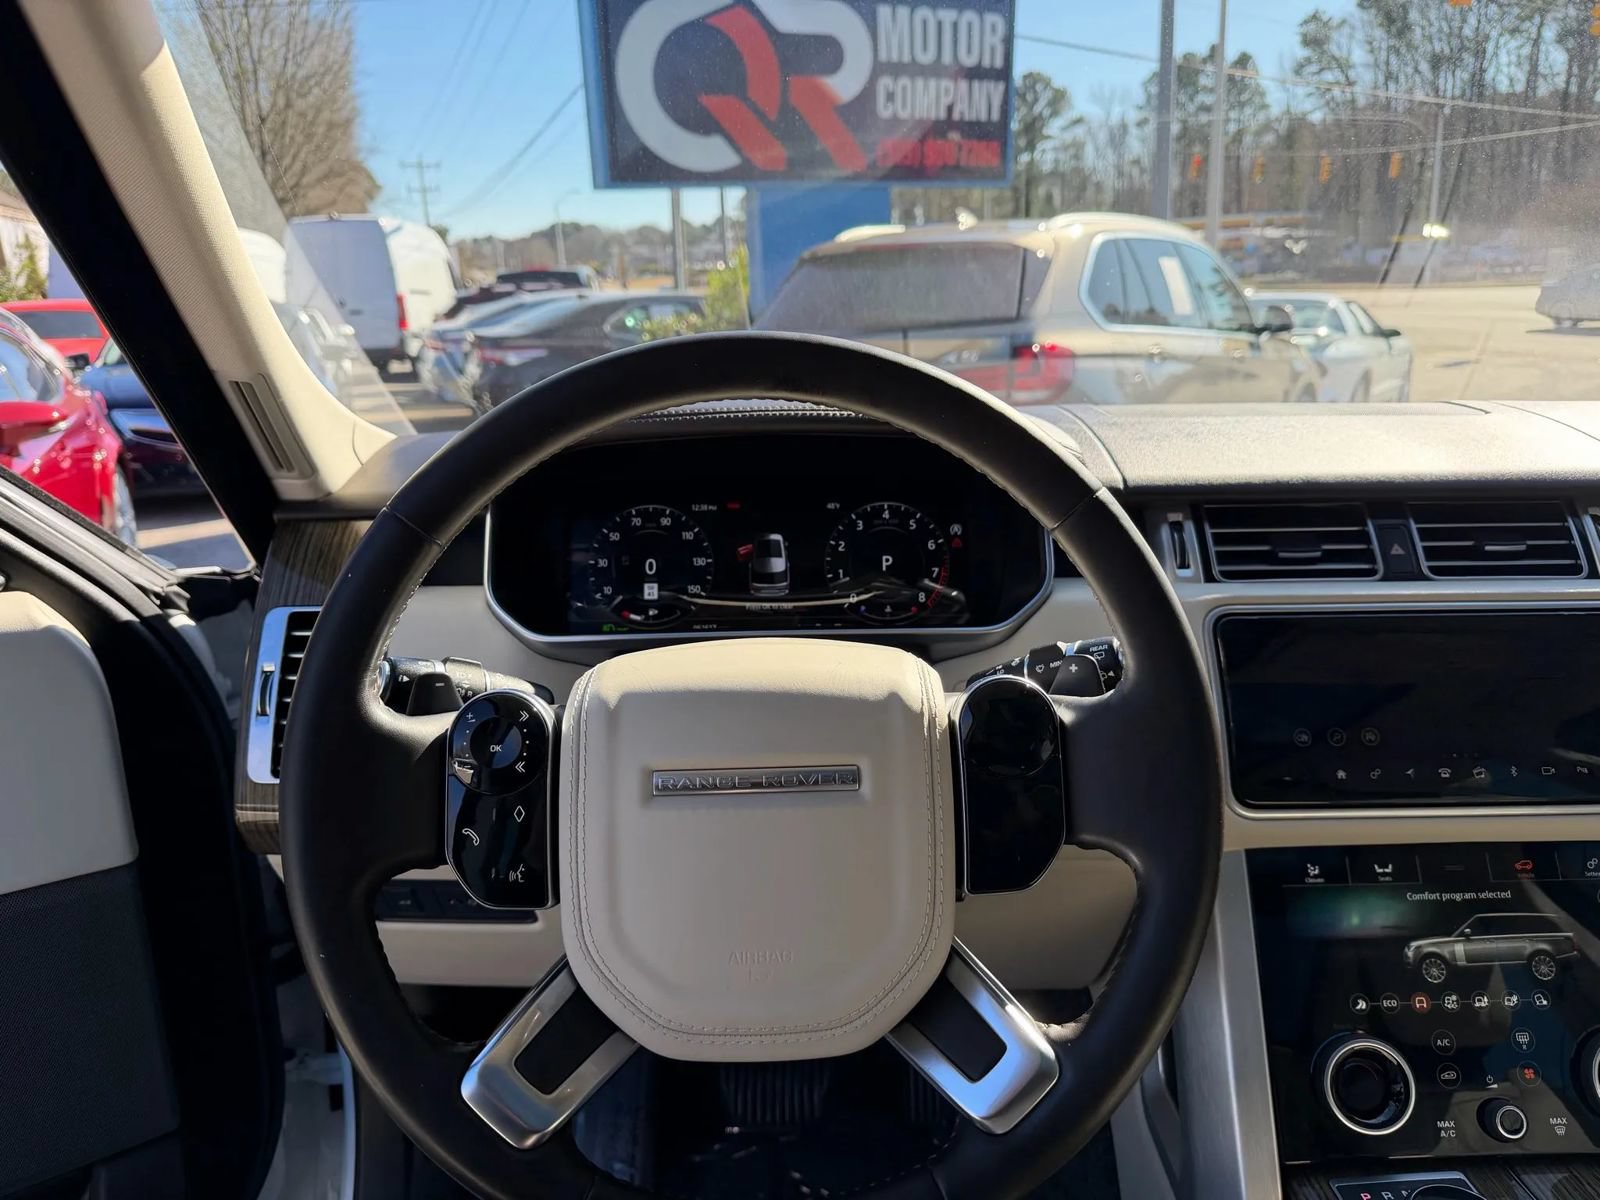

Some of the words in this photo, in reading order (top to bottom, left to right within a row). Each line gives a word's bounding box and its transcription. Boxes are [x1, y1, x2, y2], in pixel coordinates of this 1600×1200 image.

[876, 3, 1006, 69] MOTOR
[876, 75, 1006, 122] COMPANY
[882, 510, 890, 520] 4
[631, 517, 642, 526] 70
[660, 517, 671, 526] 90
[856, 520, 864, 531] 3
[909, 519, 917, 530] 5
[609, 532, 620, 541] 50
[682, 531, 694, 540] 110
[838, 541, 846, 552] 2
[927, 540, 936, 550] 6
[597, 558, 608, 568] 30
[645, 558, 657, 575] 0
[693, 557, 706, 567] 130
[882, 555, 893, 571] P
[838, 569, 844, 579] 1
[931, 567, 939, 578] 7
[603, 586, 613, 595] 10
[688, 584, 701, 594] 150
[918, 592, 926, 603] 8
[1089, 644, 1109, 652] REAR
[489, 744, 503, 753] OK
[658, 775, 754, 791] RANGE
[761, 772, 855, 788] ROVER
[1406, 891, 1440, 901] Comfort
[1441, 891, 1476, 902] program
[1478, 889, 1512, 899] selected
[1382, 999, 1398, 1008] ECO
[1436, 1038, 1451, 1047] A/C
[1437, 1120, 1456, 1128] MAX
[1549, 1117, 1568, 1125] MAX
[1440, 1129, 1456, 1138] A/C
